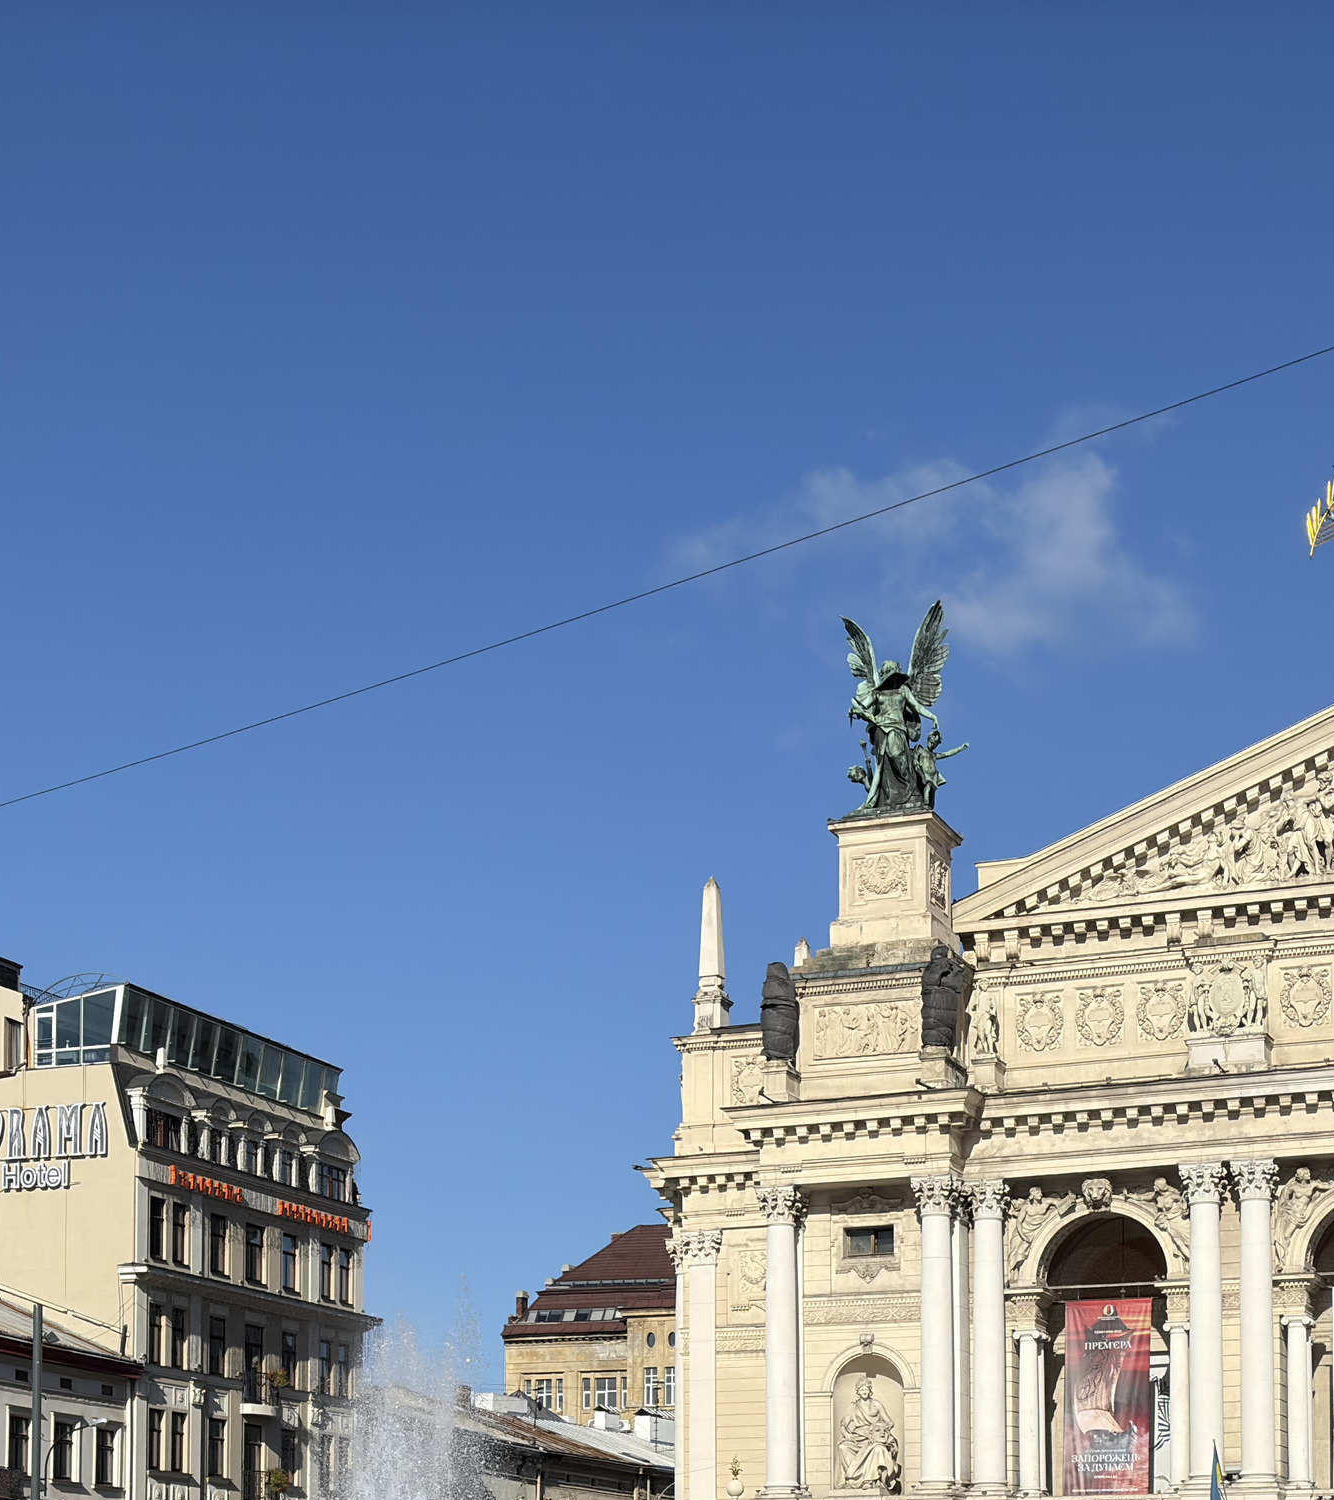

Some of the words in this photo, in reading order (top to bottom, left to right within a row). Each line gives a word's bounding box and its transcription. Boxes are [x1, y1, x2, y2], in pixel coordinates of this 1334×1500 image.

[2, 1161, 70, 1192] Hotel
[1084, 1340, 1132, 1350] ПРЕМ'ЄРА
[1071, 1453, 1141, 1463] ЗАПОРОЖЕЦЬ
[1077, 1463, 1091, 1472] ЗА
[1091, 1462, 1134, 1472] ДУНАЄМ
